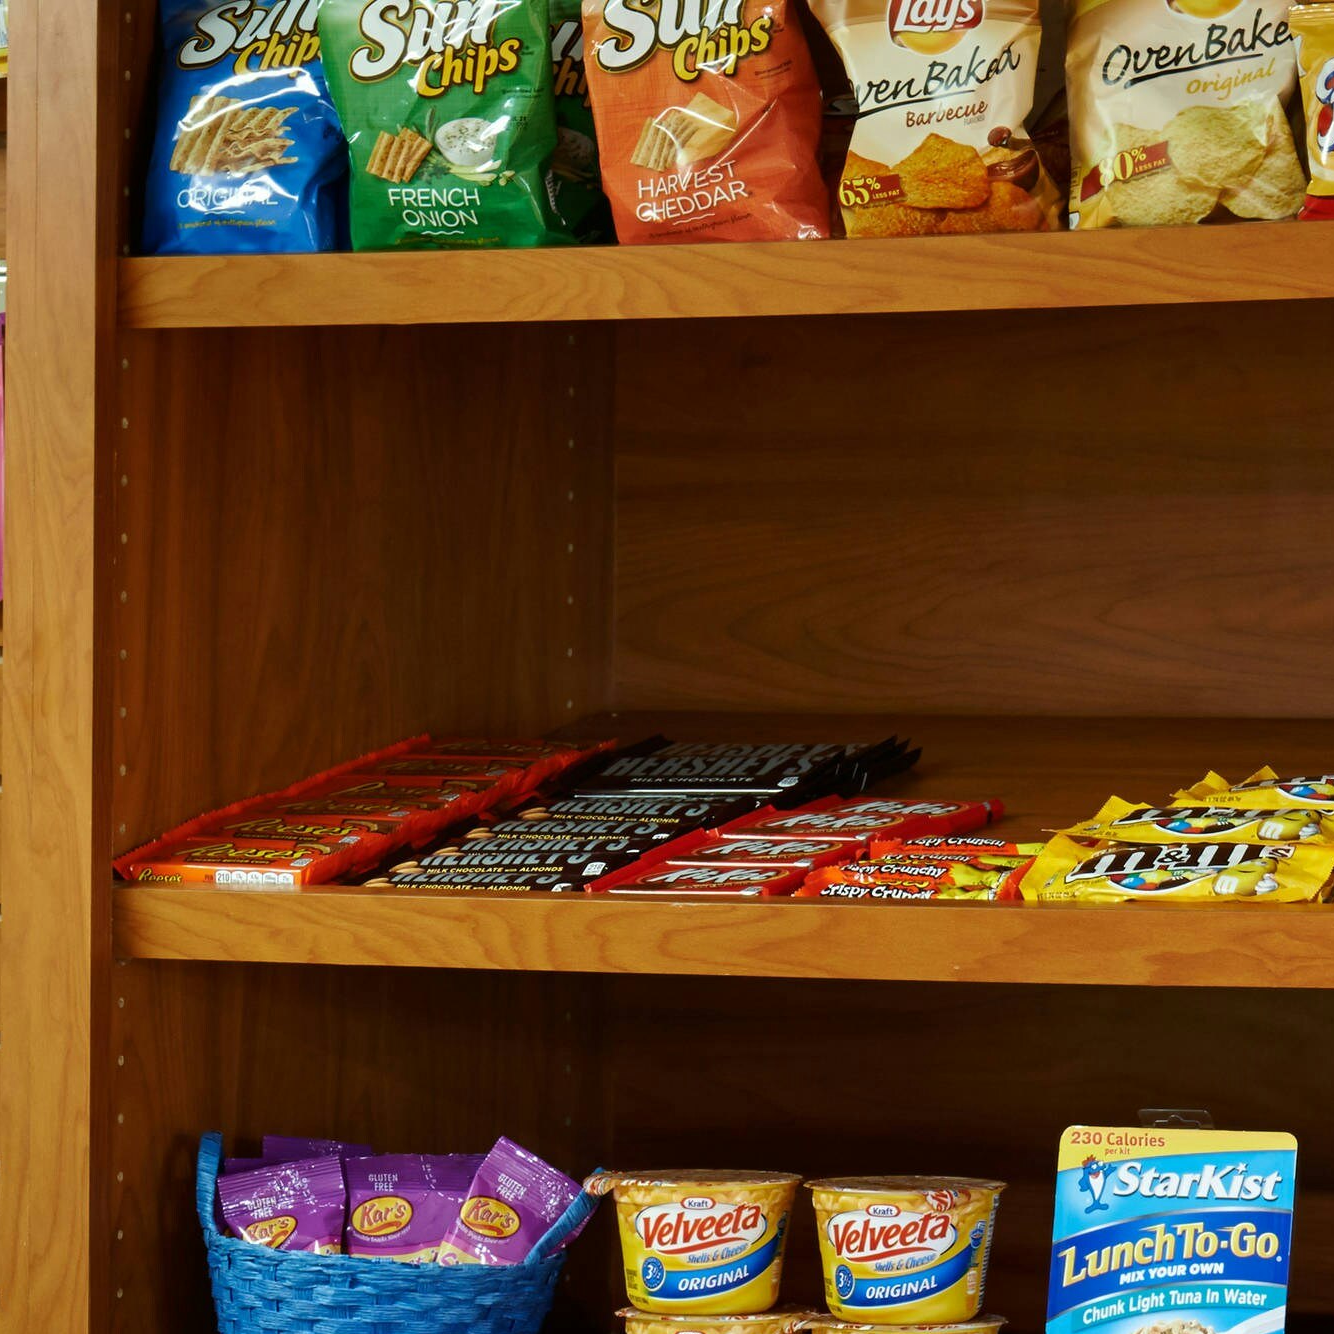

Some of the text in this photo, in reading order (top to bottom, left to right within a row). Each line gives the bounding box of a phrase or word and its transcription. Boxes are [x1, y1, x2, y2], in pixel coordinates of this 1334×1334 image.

[350, 0, 496, 78] Sun
[597, 0, 740, 70] Sun
[1103, 8, 1293, 86] Oven Bake
[673, 18, 771, 81] Chips
[417, 39, 520, 96] Chips
[906, 99, 988, 127] Barbecue
[638, 160, 737, 199] HARVEST
[839, 177, 900, 207] 65% LESS FAT
[388, 188, 480, 207] FRENCH
[636, 181, 748, 222] CHEDDAR
[402, 209, 478, 228] ONION
[601, 756, 814, 777] HERSHEY'S
[881, 864, 947, 877] Crunchy
[1070, 1132, 1165, 1147] 230 Calories
[1104, 1147, 1131, 1157] per kit
[368, 1173, 399, 1184] GLUTEN
[374, 1182, 395, 1192] FREE
[1113, 1162, 1283, 1200] StarKist
[248, 1197, 277, 1211] GLUTEN
[360, 1201, 406, 1229] Kar's
[688, 1199, 709, 1209] Kraft
[873, 1207, 894, 1216] Kraft
[643, 1202, 761, 1249] Velveeta
[833, 1212, 951, 1257] Velveeta
[678, 1265, 750, 1292] ORIGINAL
[866, 1275, 938, 1299] ORIGINAL
[1119, 1262, 1224, 1285] MIX YOUR OWN
[1082, 1288, 1267, 1325] Chunk Light Tuna In Water
